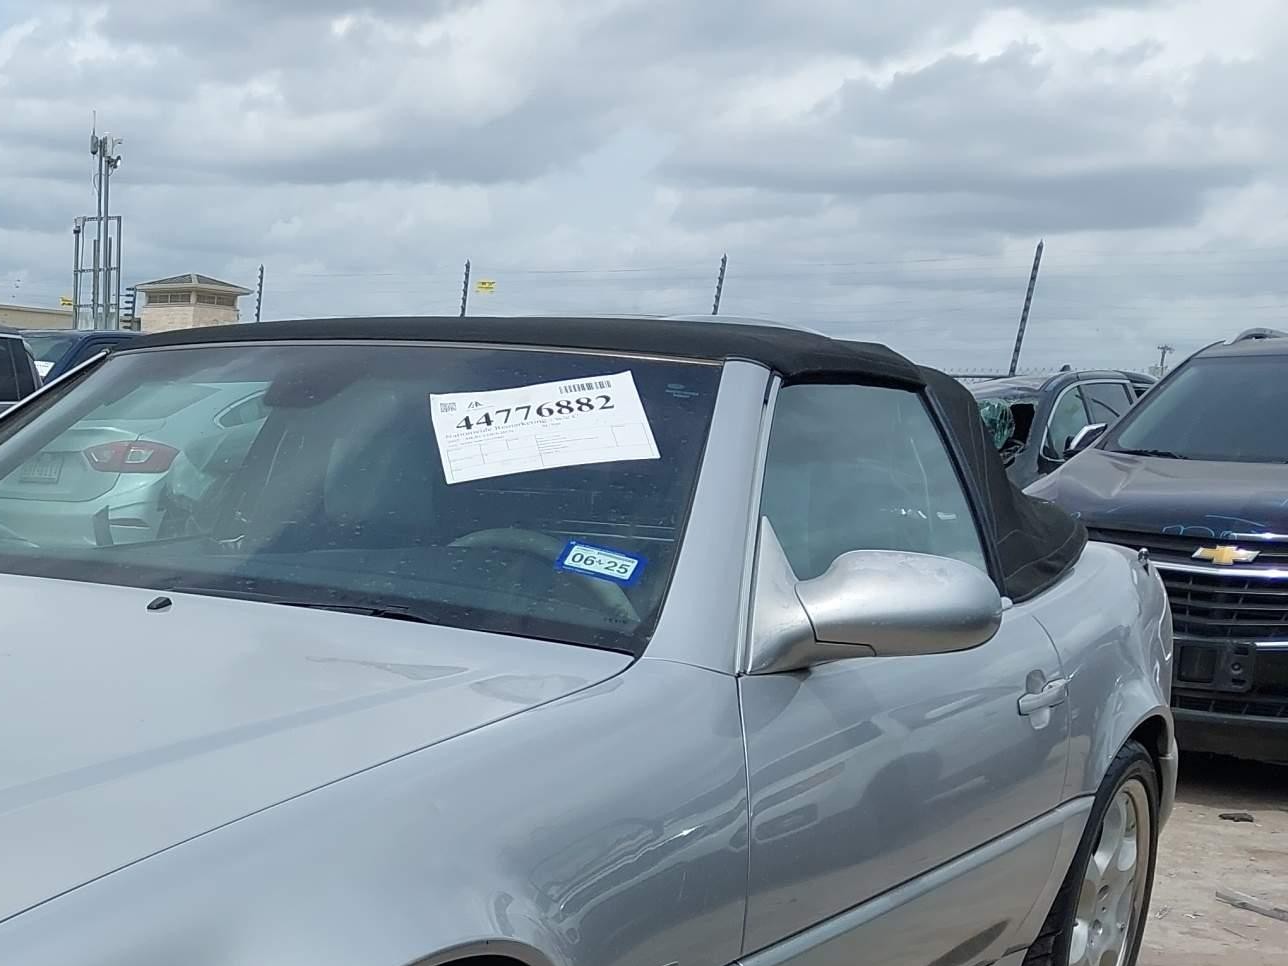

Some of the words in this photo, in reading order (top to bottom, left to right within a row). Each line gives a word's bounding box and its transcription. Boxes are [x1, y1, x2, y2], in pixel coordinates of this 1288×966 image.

[456, 394, 615, 431] 44776882
[571, 552, 597, 566] 06
[604, 560, 631, 575] 25
